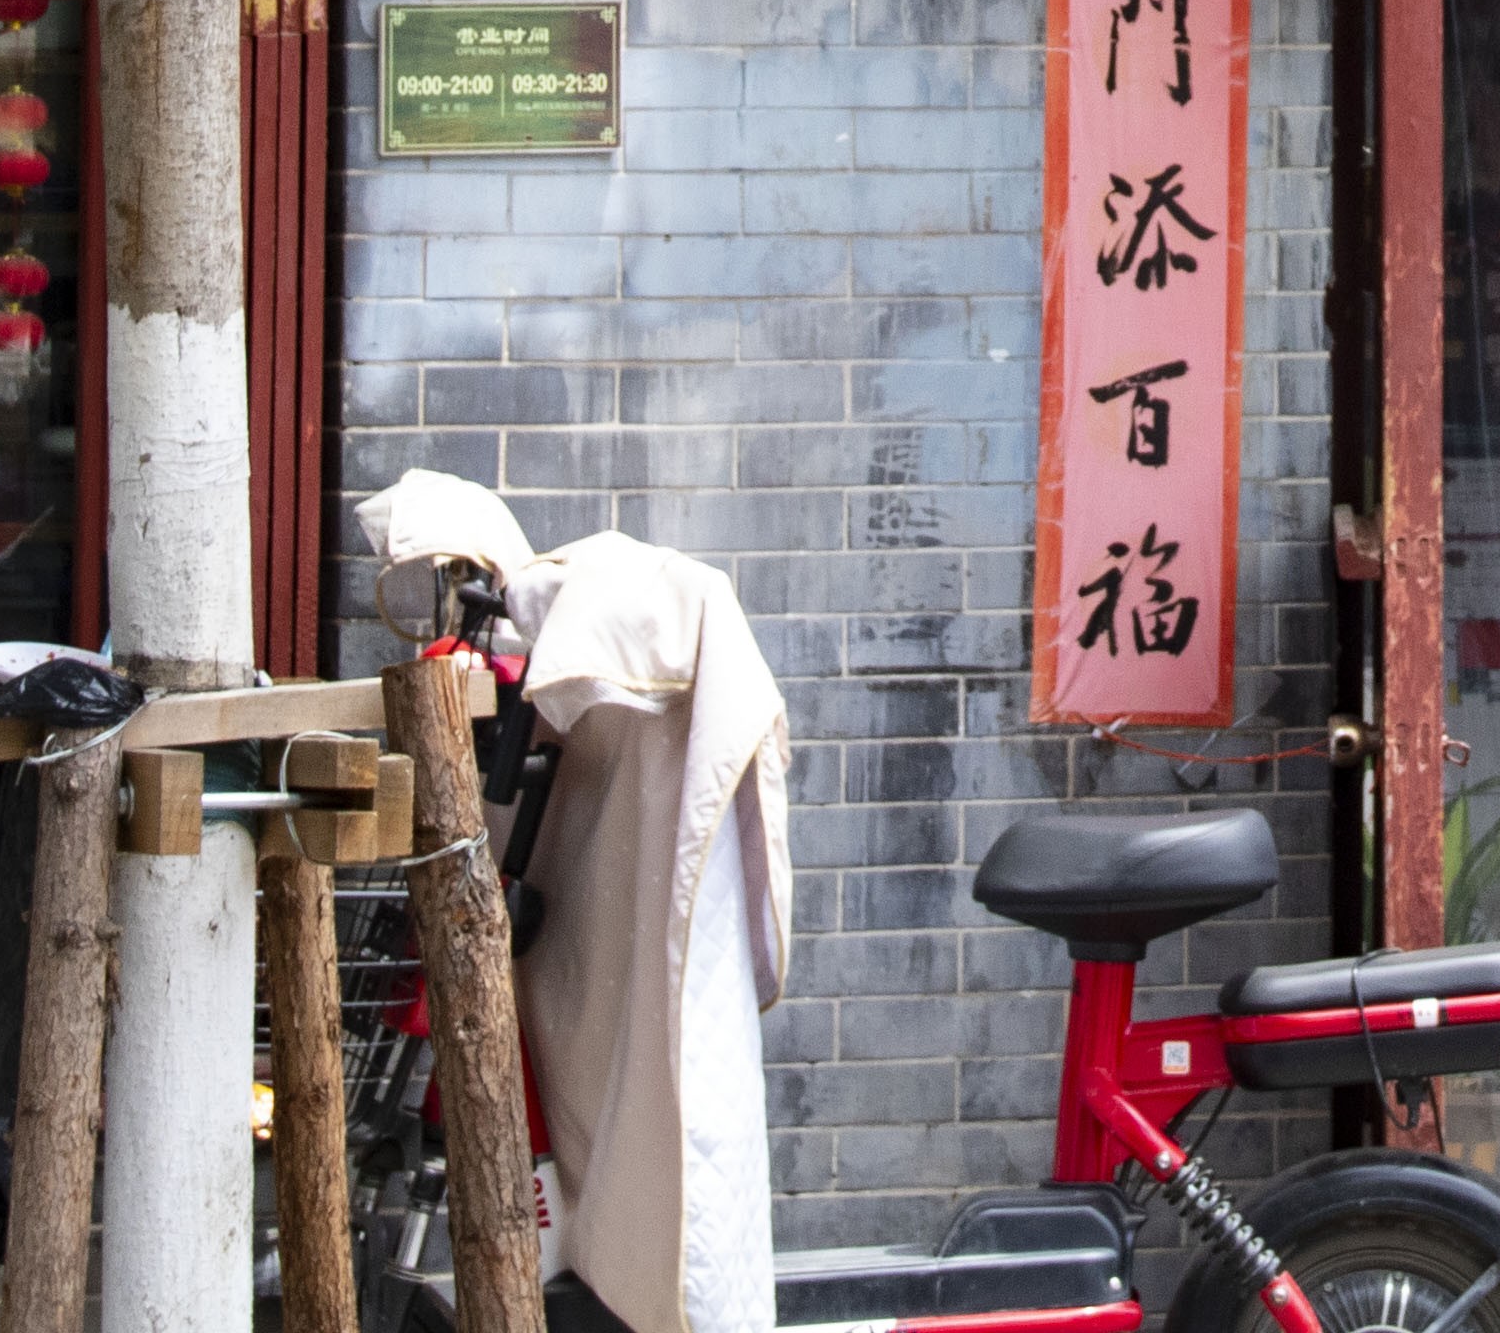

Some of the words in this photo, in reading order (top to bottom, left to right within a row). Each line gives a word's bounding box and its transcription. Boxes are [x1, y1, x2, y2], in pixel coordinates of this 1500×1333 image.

[456, 27, 550, 45] 营业时间
[397, 75, 494, 96] 09:00-21:00
[512, 73, 609, 95] 09:30-21:30
